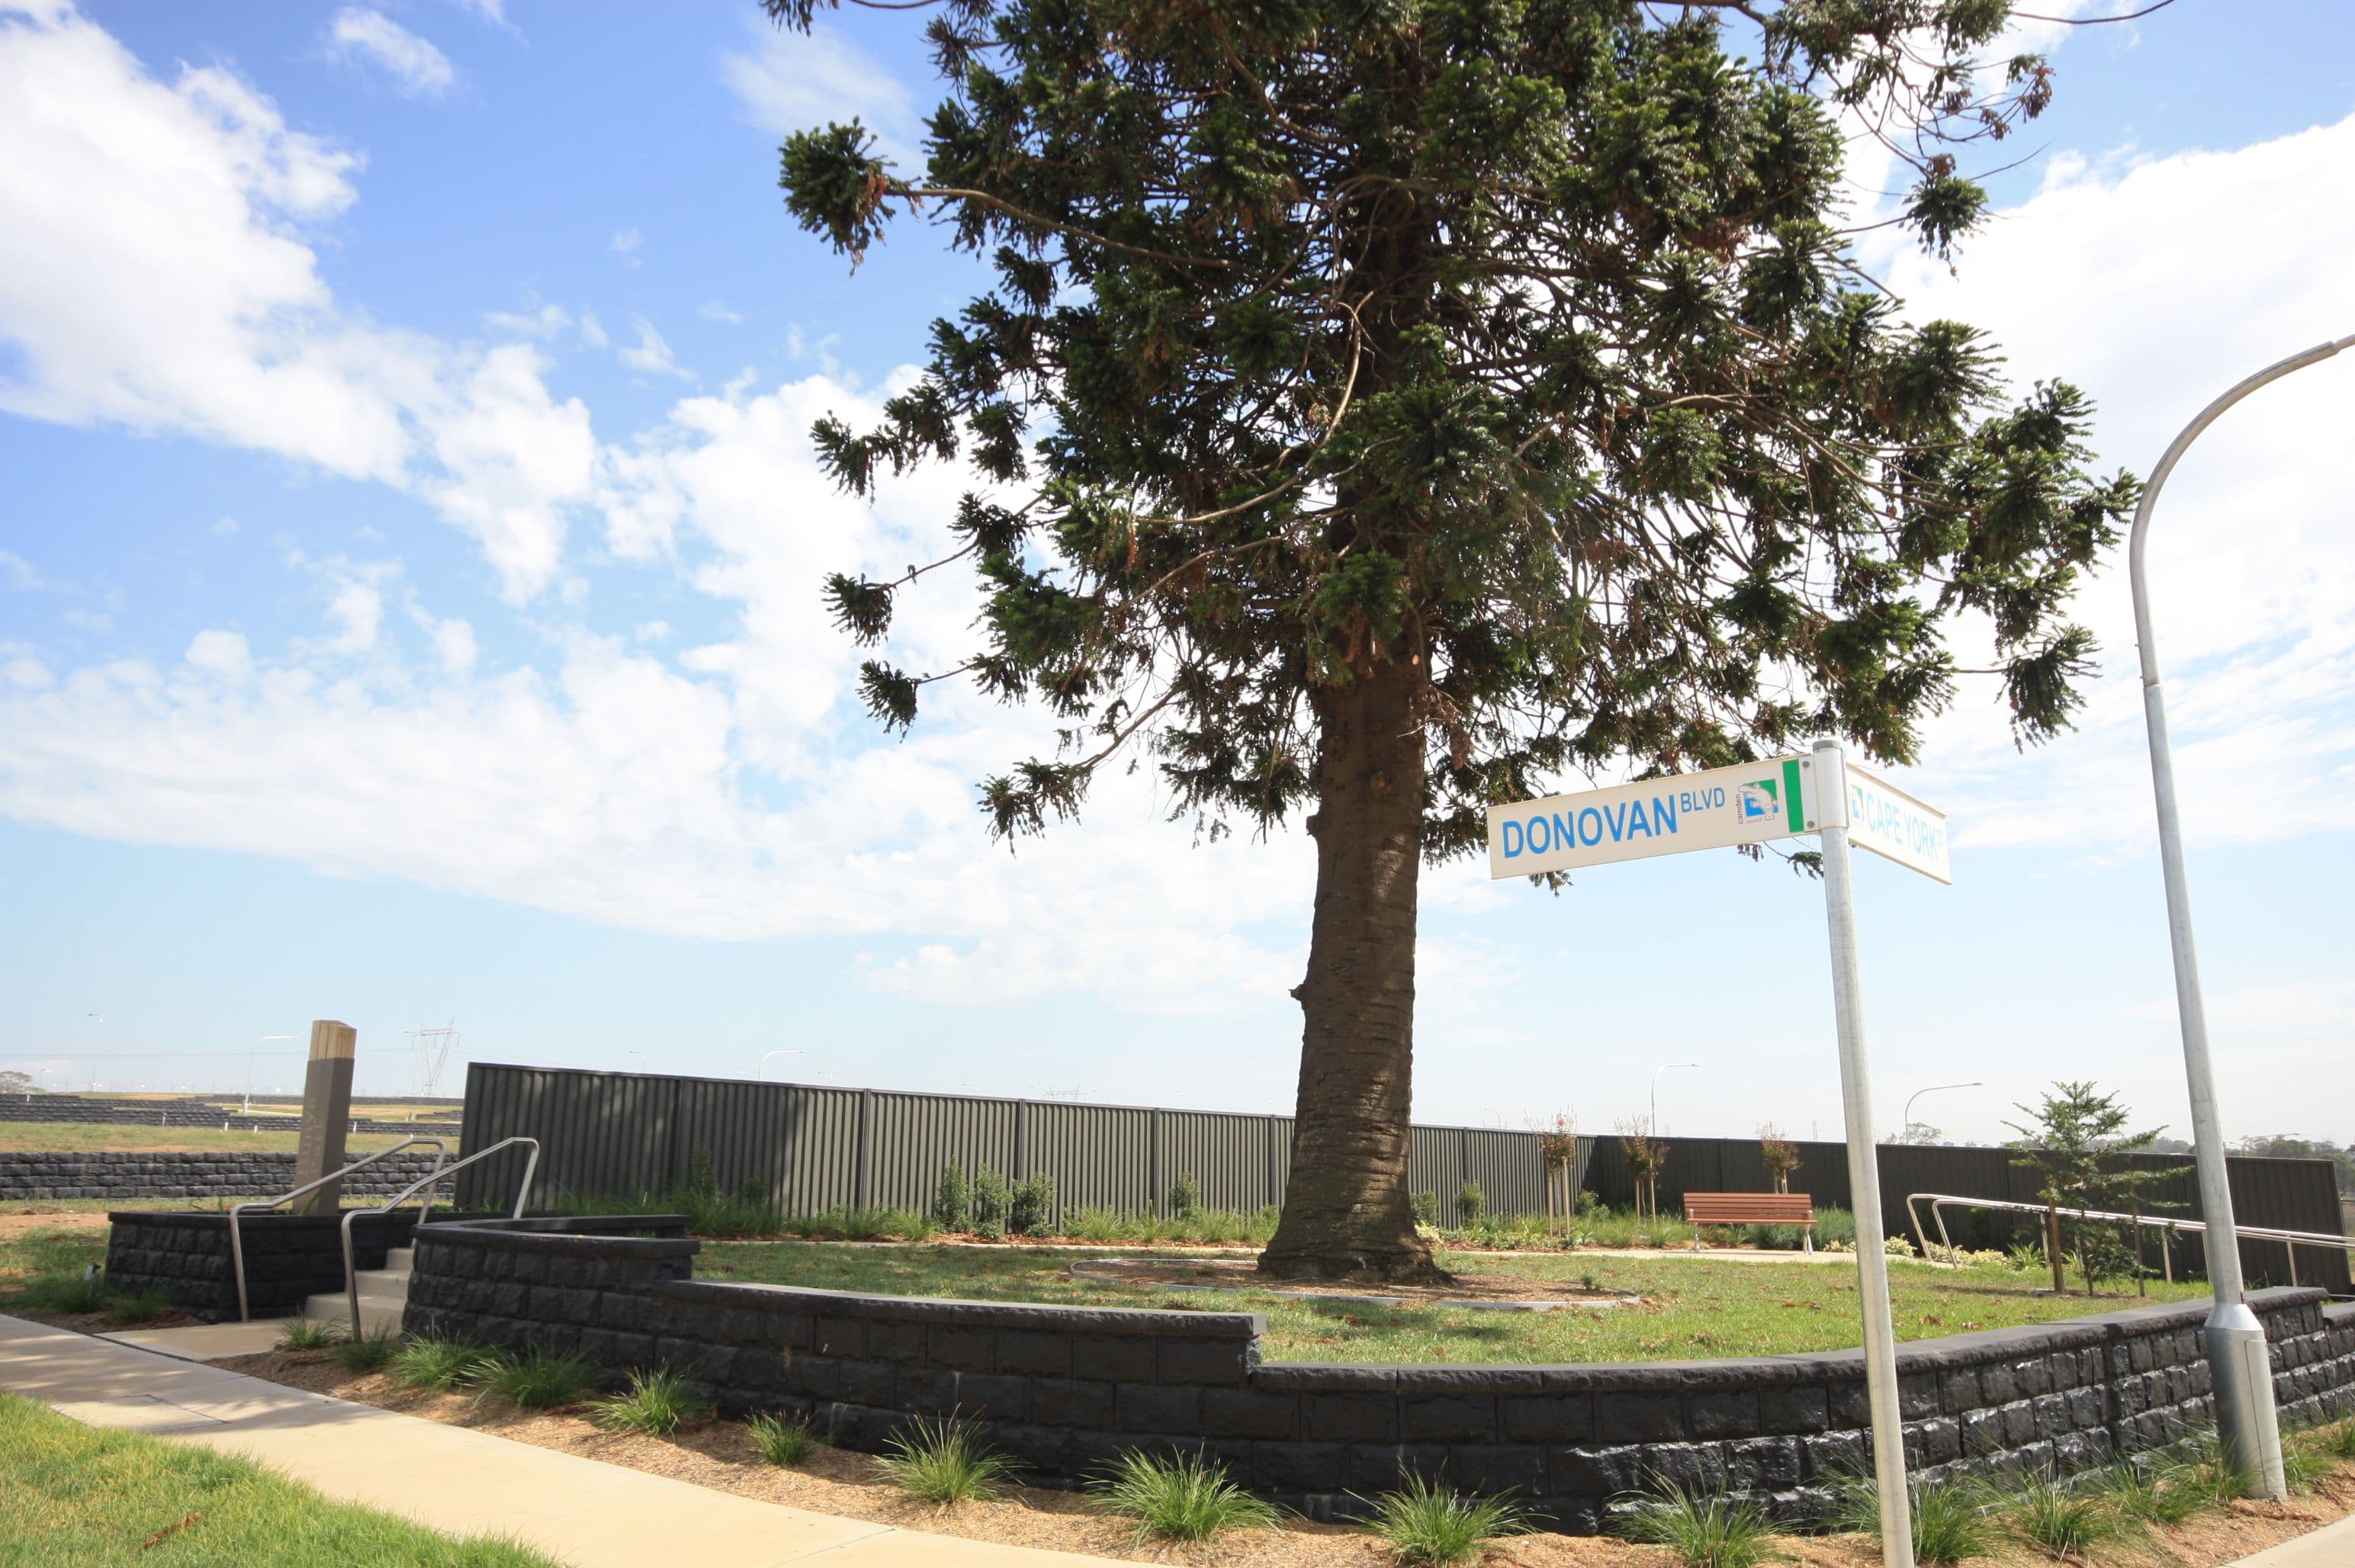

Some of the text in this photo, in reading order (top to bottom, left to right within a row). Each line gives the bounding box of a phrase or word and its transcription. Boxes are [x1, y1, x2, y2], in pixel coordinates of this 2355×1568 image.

[1502, 787, 1726, 859] DONOVAN BLVD
[1735, 793, 1743, 824] camden
[1866, 792, 1903, 846] CAPE
[1904, 810, 1939, 863] YORK
